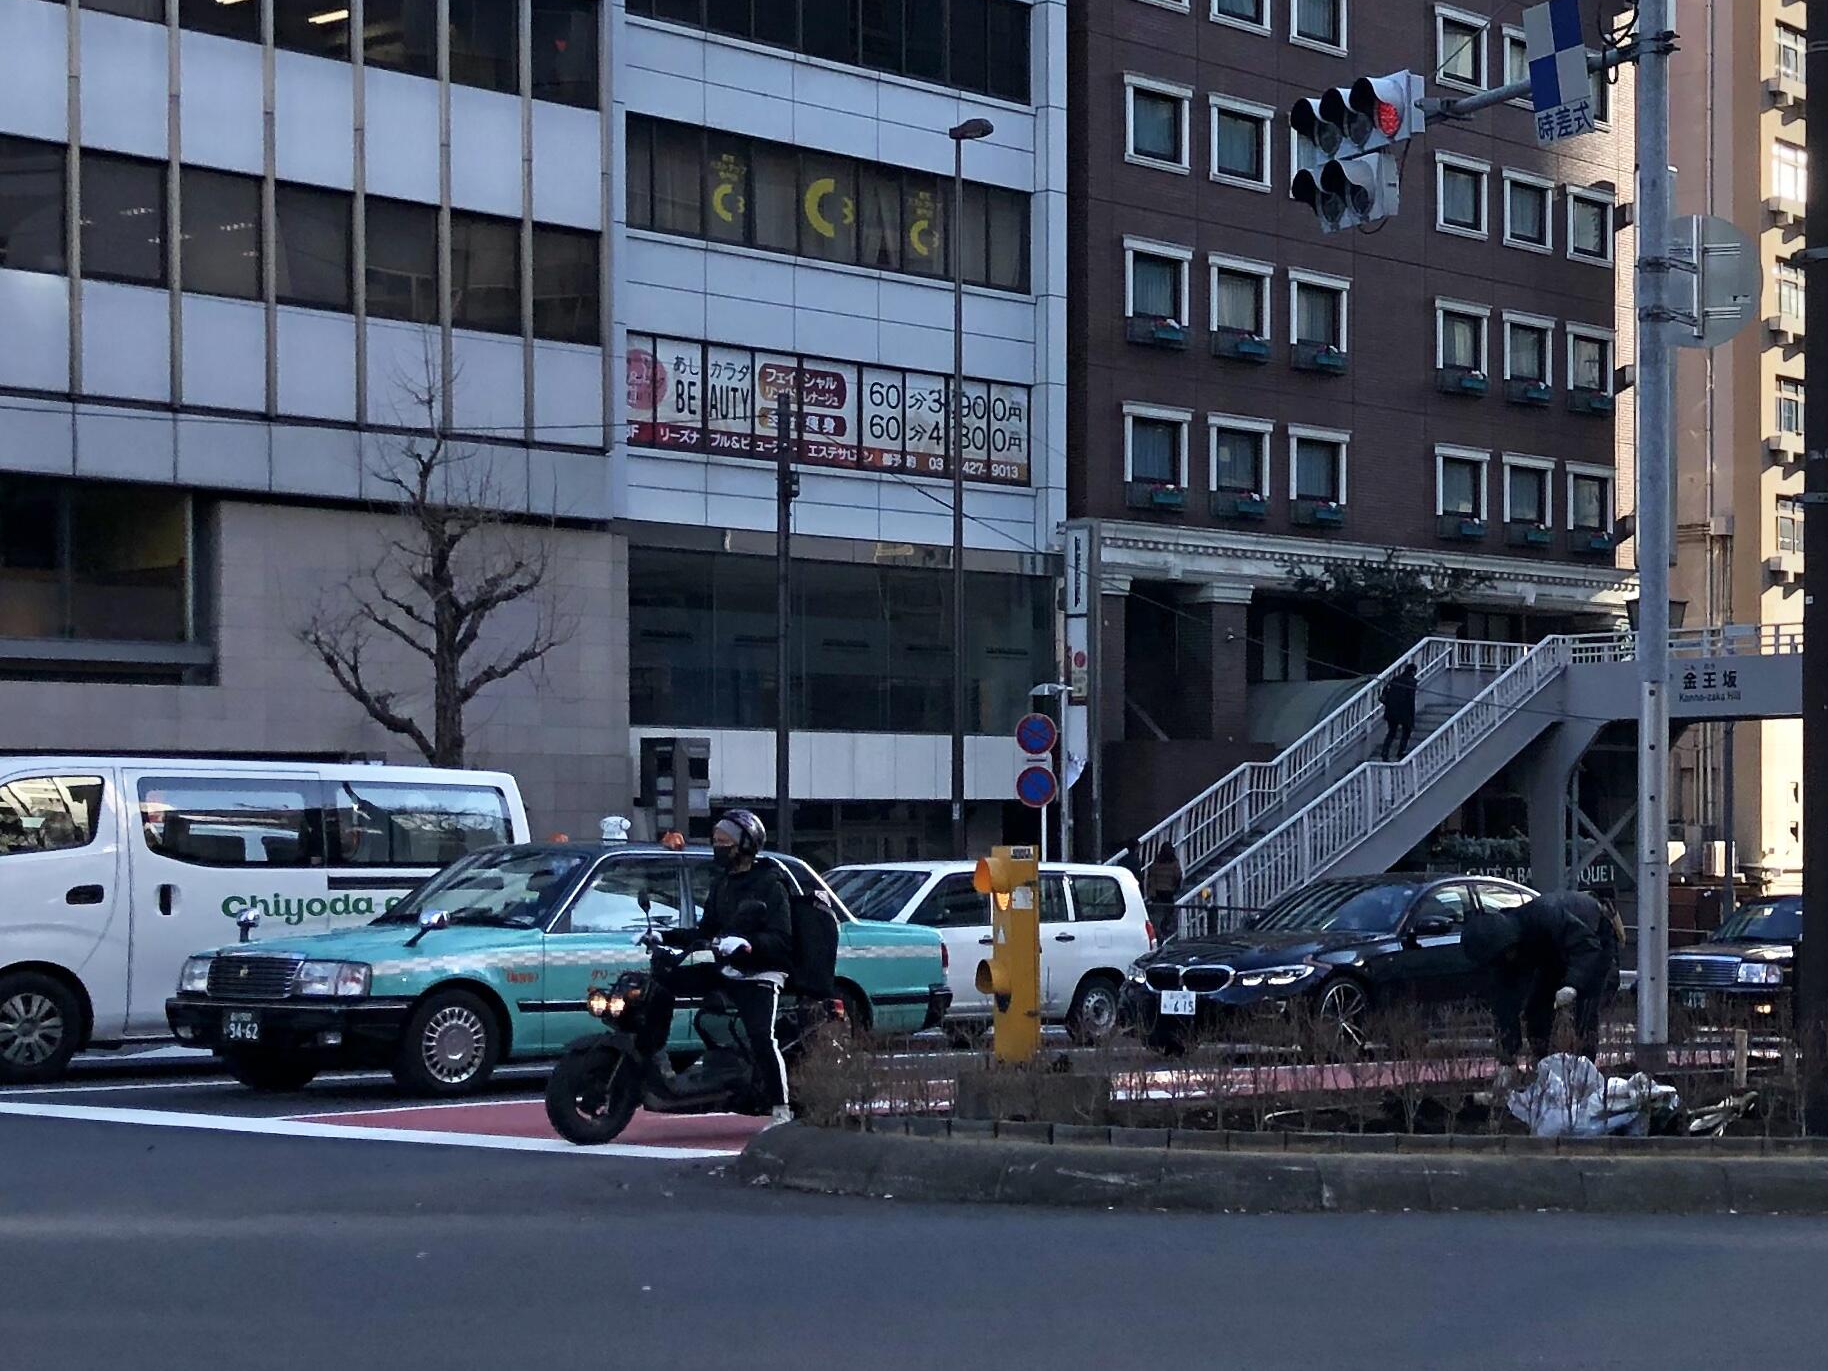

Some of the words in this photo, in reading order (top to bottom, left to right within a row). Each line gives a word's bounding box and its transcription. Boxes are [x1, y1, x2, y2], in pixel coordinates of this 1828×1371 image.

[1537, 101, 1594, 143] 時差式
[765, 368, 838, 390] フェイシャル
[675, 378, 750, 422] BEAUTY
[928, 456, 1020, 479] 03-427-9013
[1683, 670, 1737, 690] 金王坂
